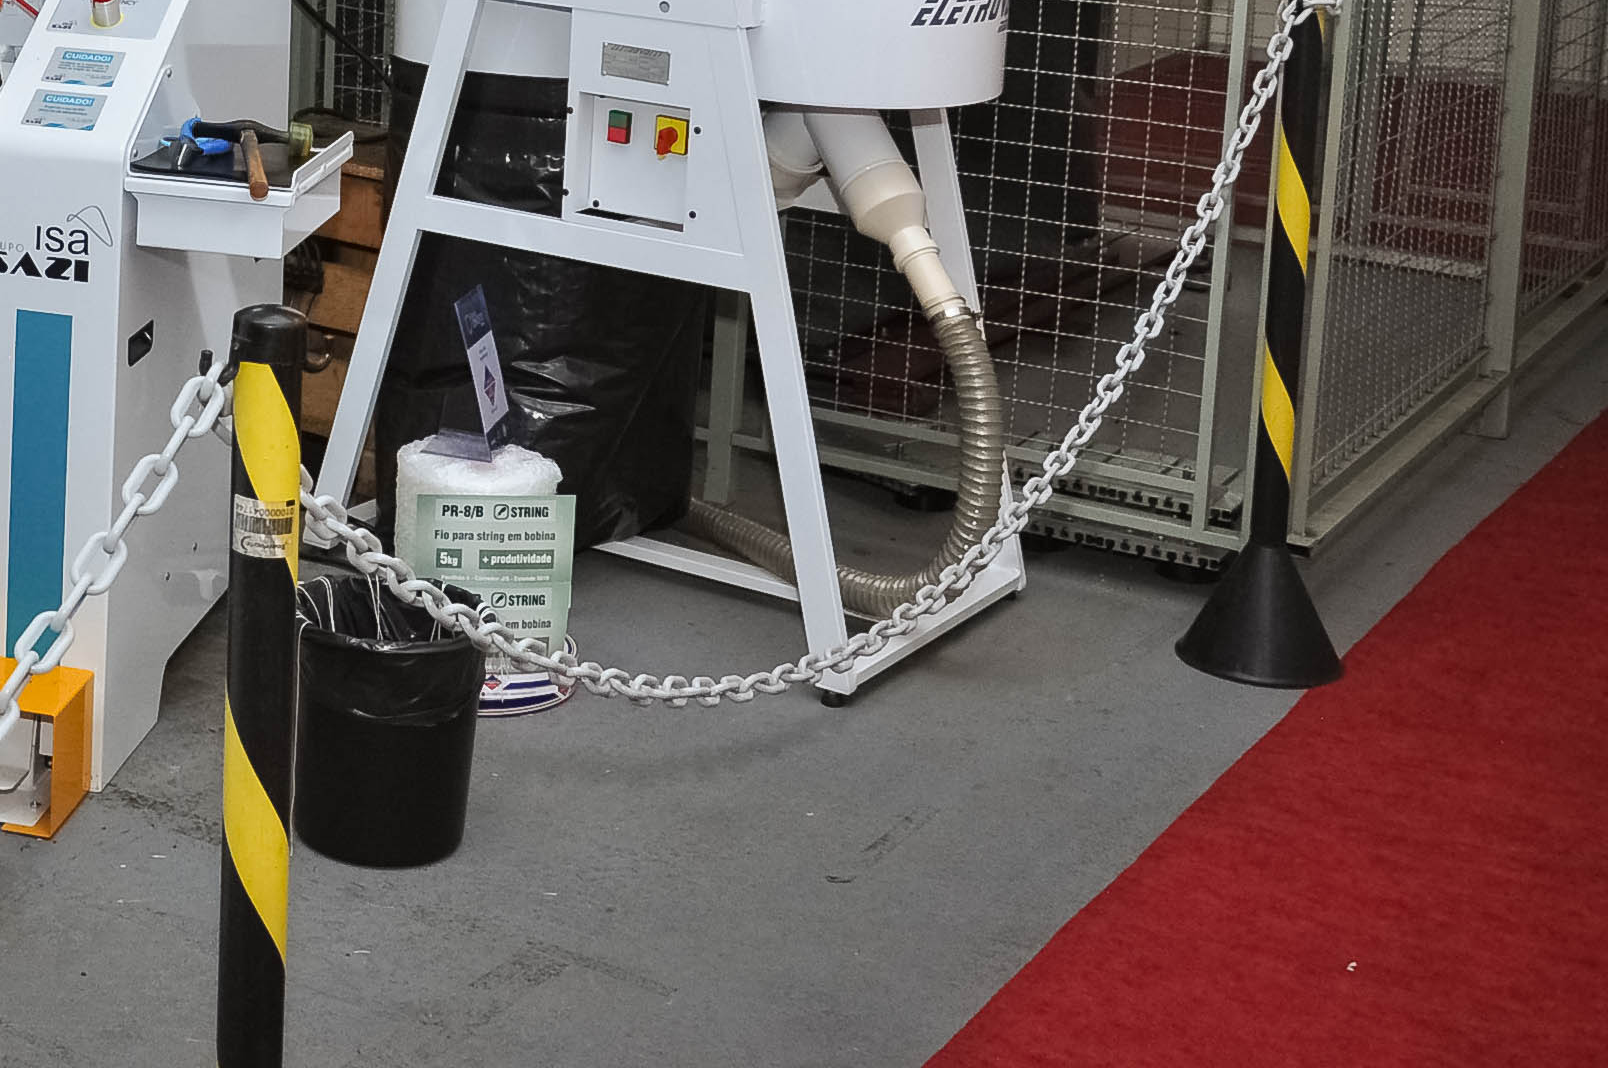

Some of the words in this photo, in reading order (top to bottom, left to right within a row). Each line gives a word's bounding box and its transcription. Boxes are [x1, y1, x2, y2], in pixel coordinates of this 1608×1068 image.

[65, 52, 112, 62] CUIDADO!
[45, 95, 93, 105] CUIDADO!
[442, 504, 484, 519] PR-8/B
[510, 506, 549, 518] STRING
[452, 532, 474, 542] para
[477, 531, 504, 543] string
[524, 531, 556, 541] bobina
[439, 552, 459, 566] 5kg
[491, 553, 552, 565] produtividade
[508, 594, 546, 607] STRING
[505, 621, 519, 629] em
[521, 619, 552, 629] bobina
